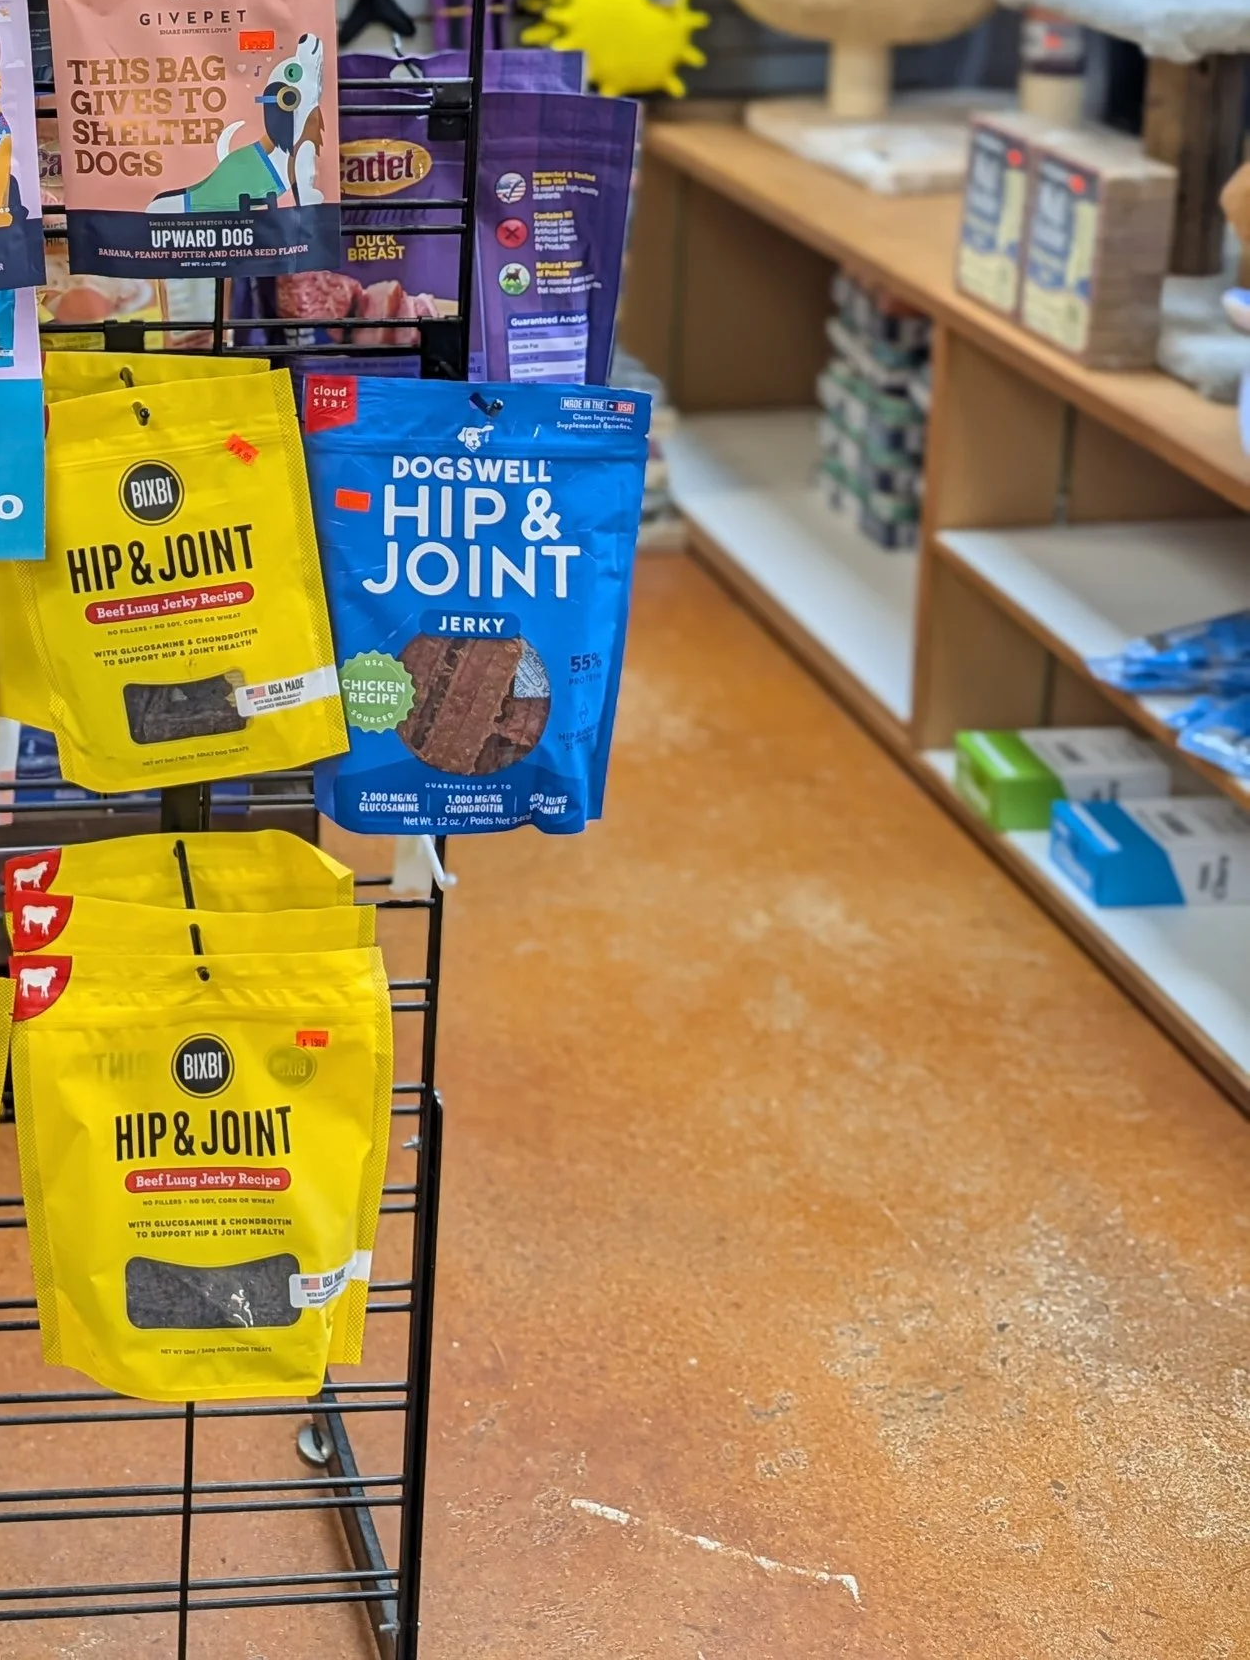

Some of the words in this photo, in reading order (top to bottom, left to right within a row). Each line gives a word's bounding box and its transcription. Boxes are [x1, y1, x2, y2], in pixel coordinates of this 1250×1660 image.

[140, 10, 246, 25] GIVEPET
[151, 229, 217, 249] UPWARD
[223, 228, 253, 247] DOG
[355, 235, 396, 247] DUCK
[99, 248, 134, 259] BANANA,
[135, 250, 169, 259] PEANUT
[172, 251, 205, 259] BUTTER
[208, 249, 227, 258] AND
[229, 248, 252, 257] CHIA
[254, 247, 276, 256] SEED
[278, 244, 308, 255] FLAVOR
[348, 246, 405, 260] BREAST
[313, 385, 347, 397] cloud
[564, 399, 582, 408] MADE
[583, 400, 590, 408] IN
[592, 400, 604, 409] THE
[618, 403, 631, 411] USA
[392, 456, 552, 483] DOGSWELL
[384, 484, 506, 540] HIP
[521, 488, 562, 541] &
[362, 541, 581, 598] JOINT
[438, 615, 505, 634] JERKY
[365, 659, 384, 667] USA
[570, 653, 602, 673] 55%
[341, 678, 405, 693] CHICKEN
[348, 691, 398, 705] RECIPE
[350, 709, 394, 724] SOURCED
[390, 793, 418, 802] MG/KG
[475, 794, 502, 803] MG/KG
[359, 802, 419, 812] GLUCOSAMINE
[445, 804, 503, 813] CHONDROITIN
[403, 817, 418, 825] Net
[419, 817, 432, 825] Wt.
[437, 818, 447, 826] 12
[136, 1175, 163, 1188] Beef
[165, 1175, 197, 1188] Lung
[200, 1174, 235, 1188] Jerky
[238, 1174, 281, 1188] Recipe
[128, 1219, 152, 1229] WITH
[154, 1218, 218, 1228] GLUCOSAMINE
[221, 1218, 227, 1226] &
[229, 1218, 292, 1227] CHONDROITIN
[136, 1231, 148, 1239] TO
[151, 1230, 192, 1239] SUPPORT
[194, 1229, 209, 1238] HIP
[221, 1228, 248, 1237] JOINT
[250, 1228, 285, 1236] HEALTH
